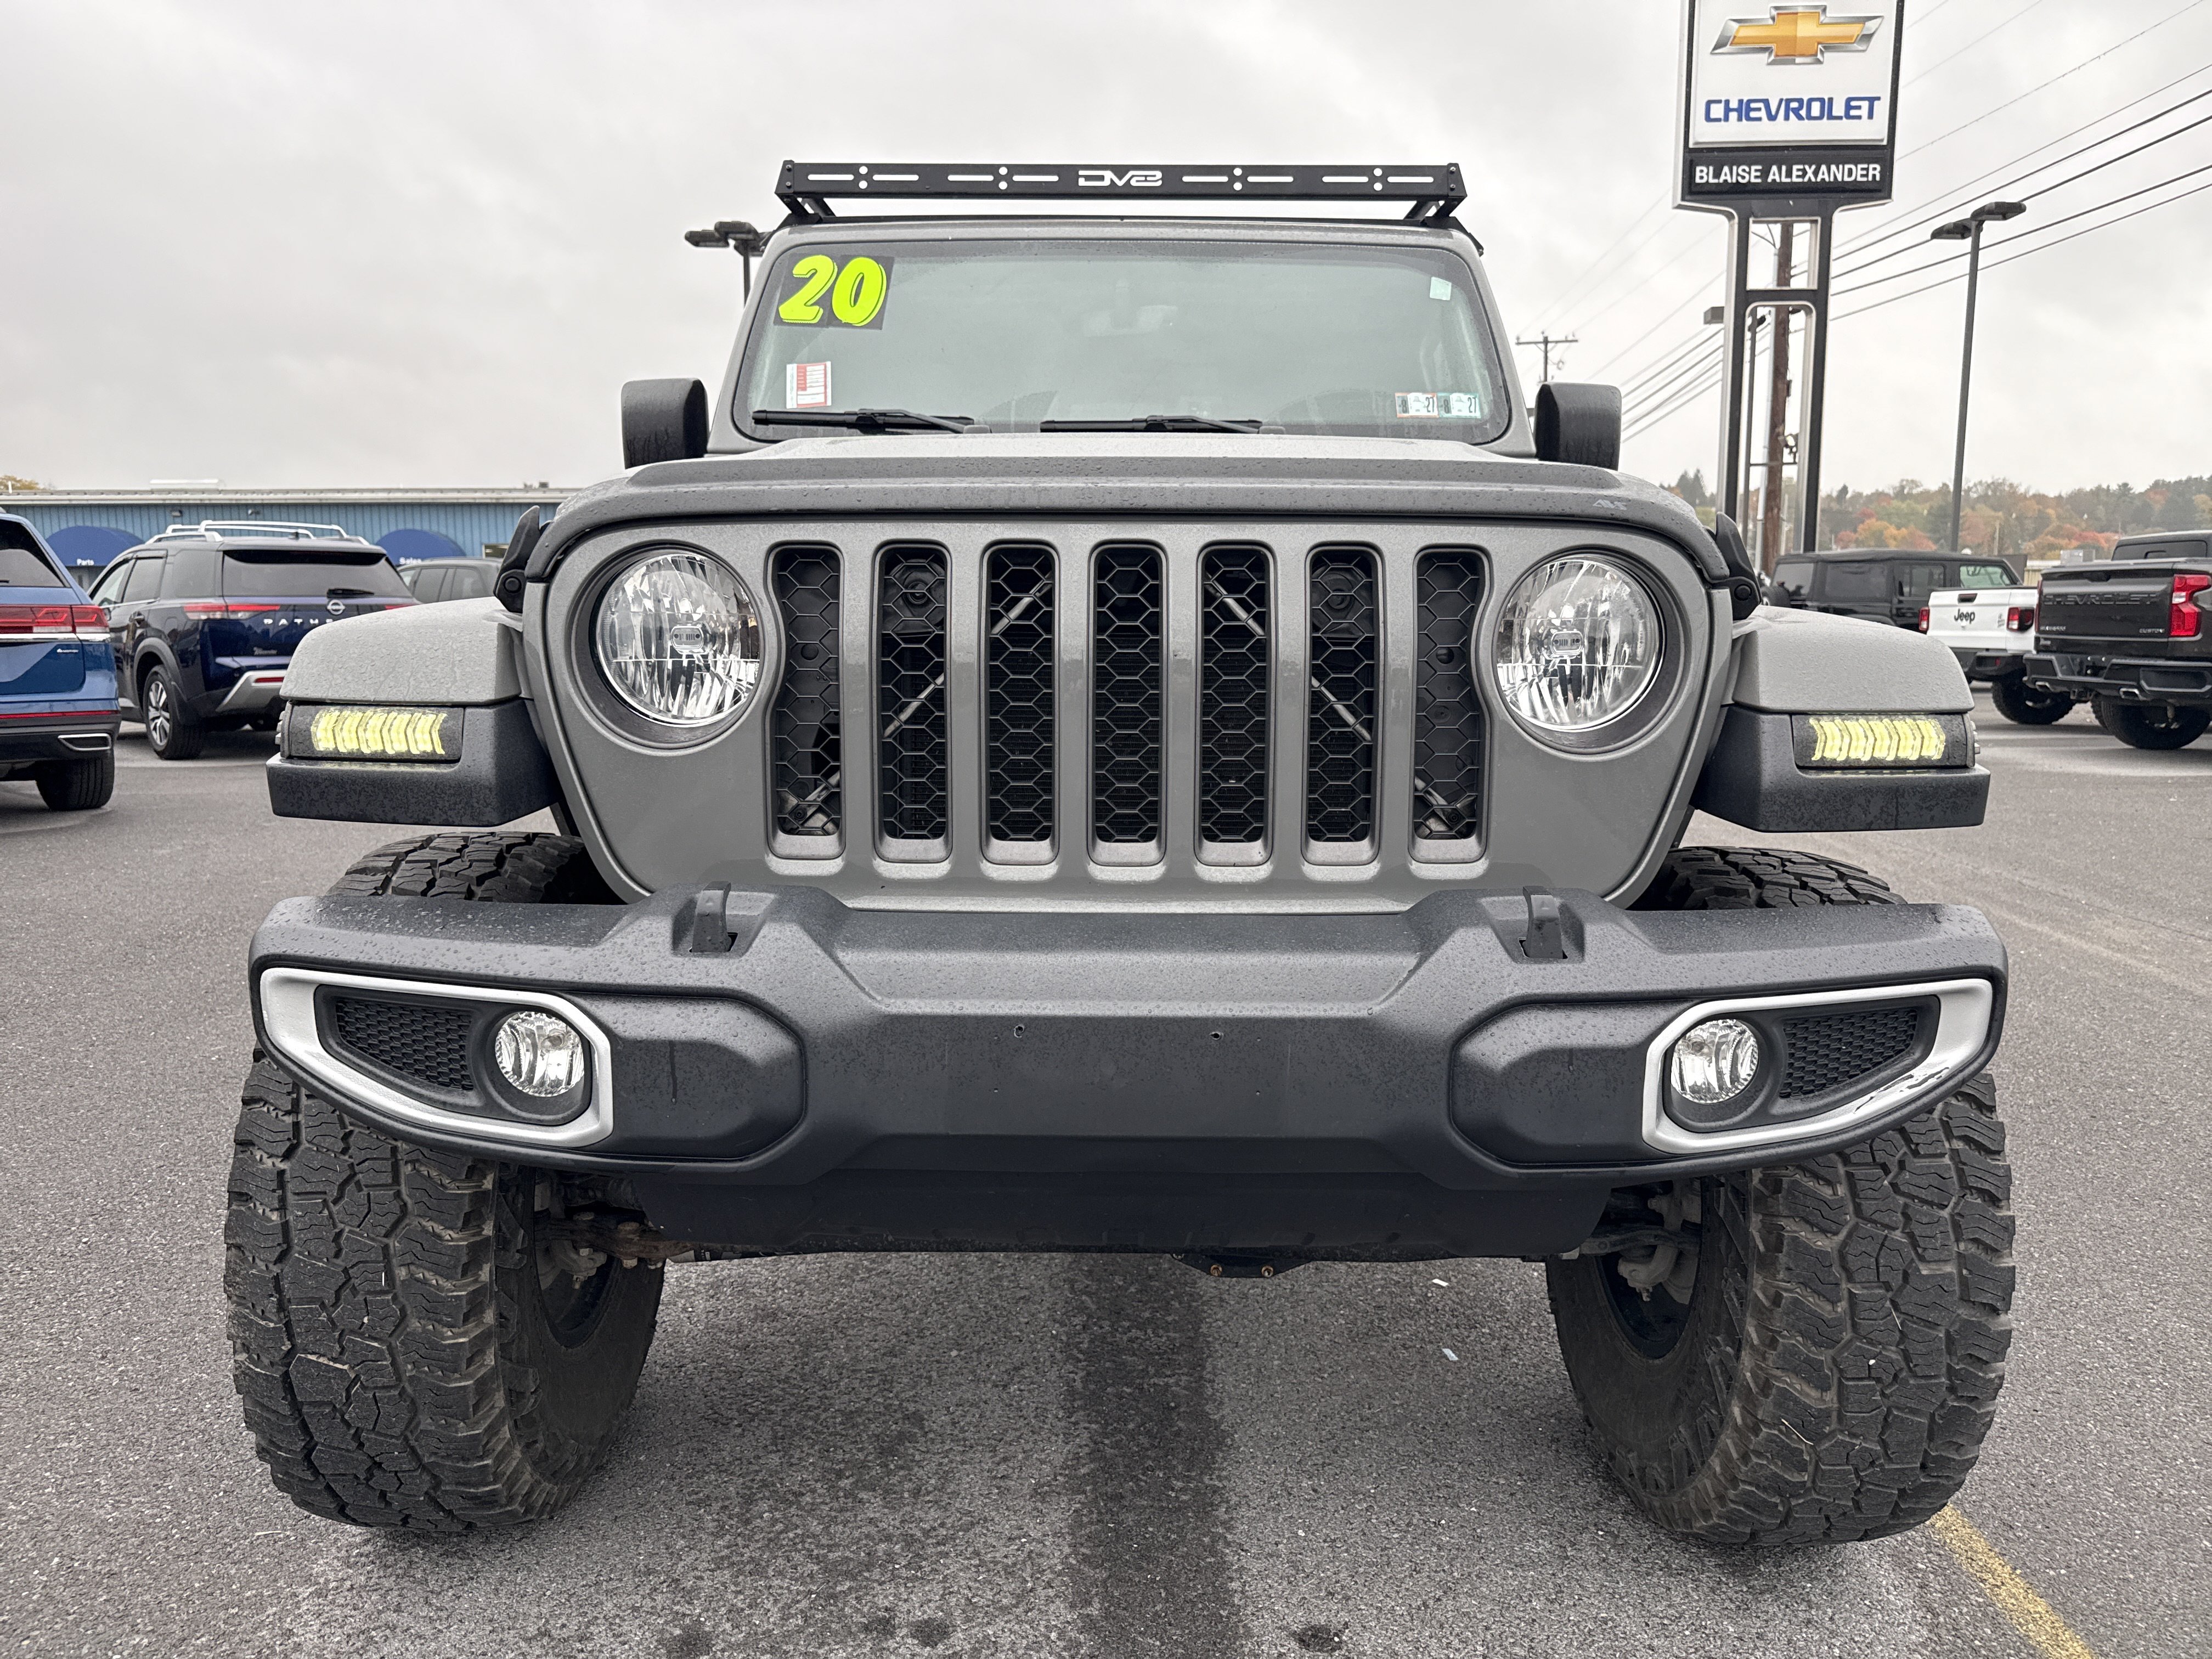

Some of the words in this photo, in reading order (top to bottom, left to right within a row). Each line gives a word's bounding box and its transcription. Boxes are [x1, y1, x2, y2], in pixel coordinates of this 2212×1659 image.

[1705, 97, 1881, 122] CHEVROLET
[1695, 165, 1762, 184] BLAISE
[1768, 163, 1881, 183] ALEXANDER
[778, 255, 887, 326] 20
[1425, 396, 1435, 413] 27
[1467, 397, 1477, 413] 27
[399, 557, 422, 565] Sales
[1954, 608, 1976, 624] Jeep
